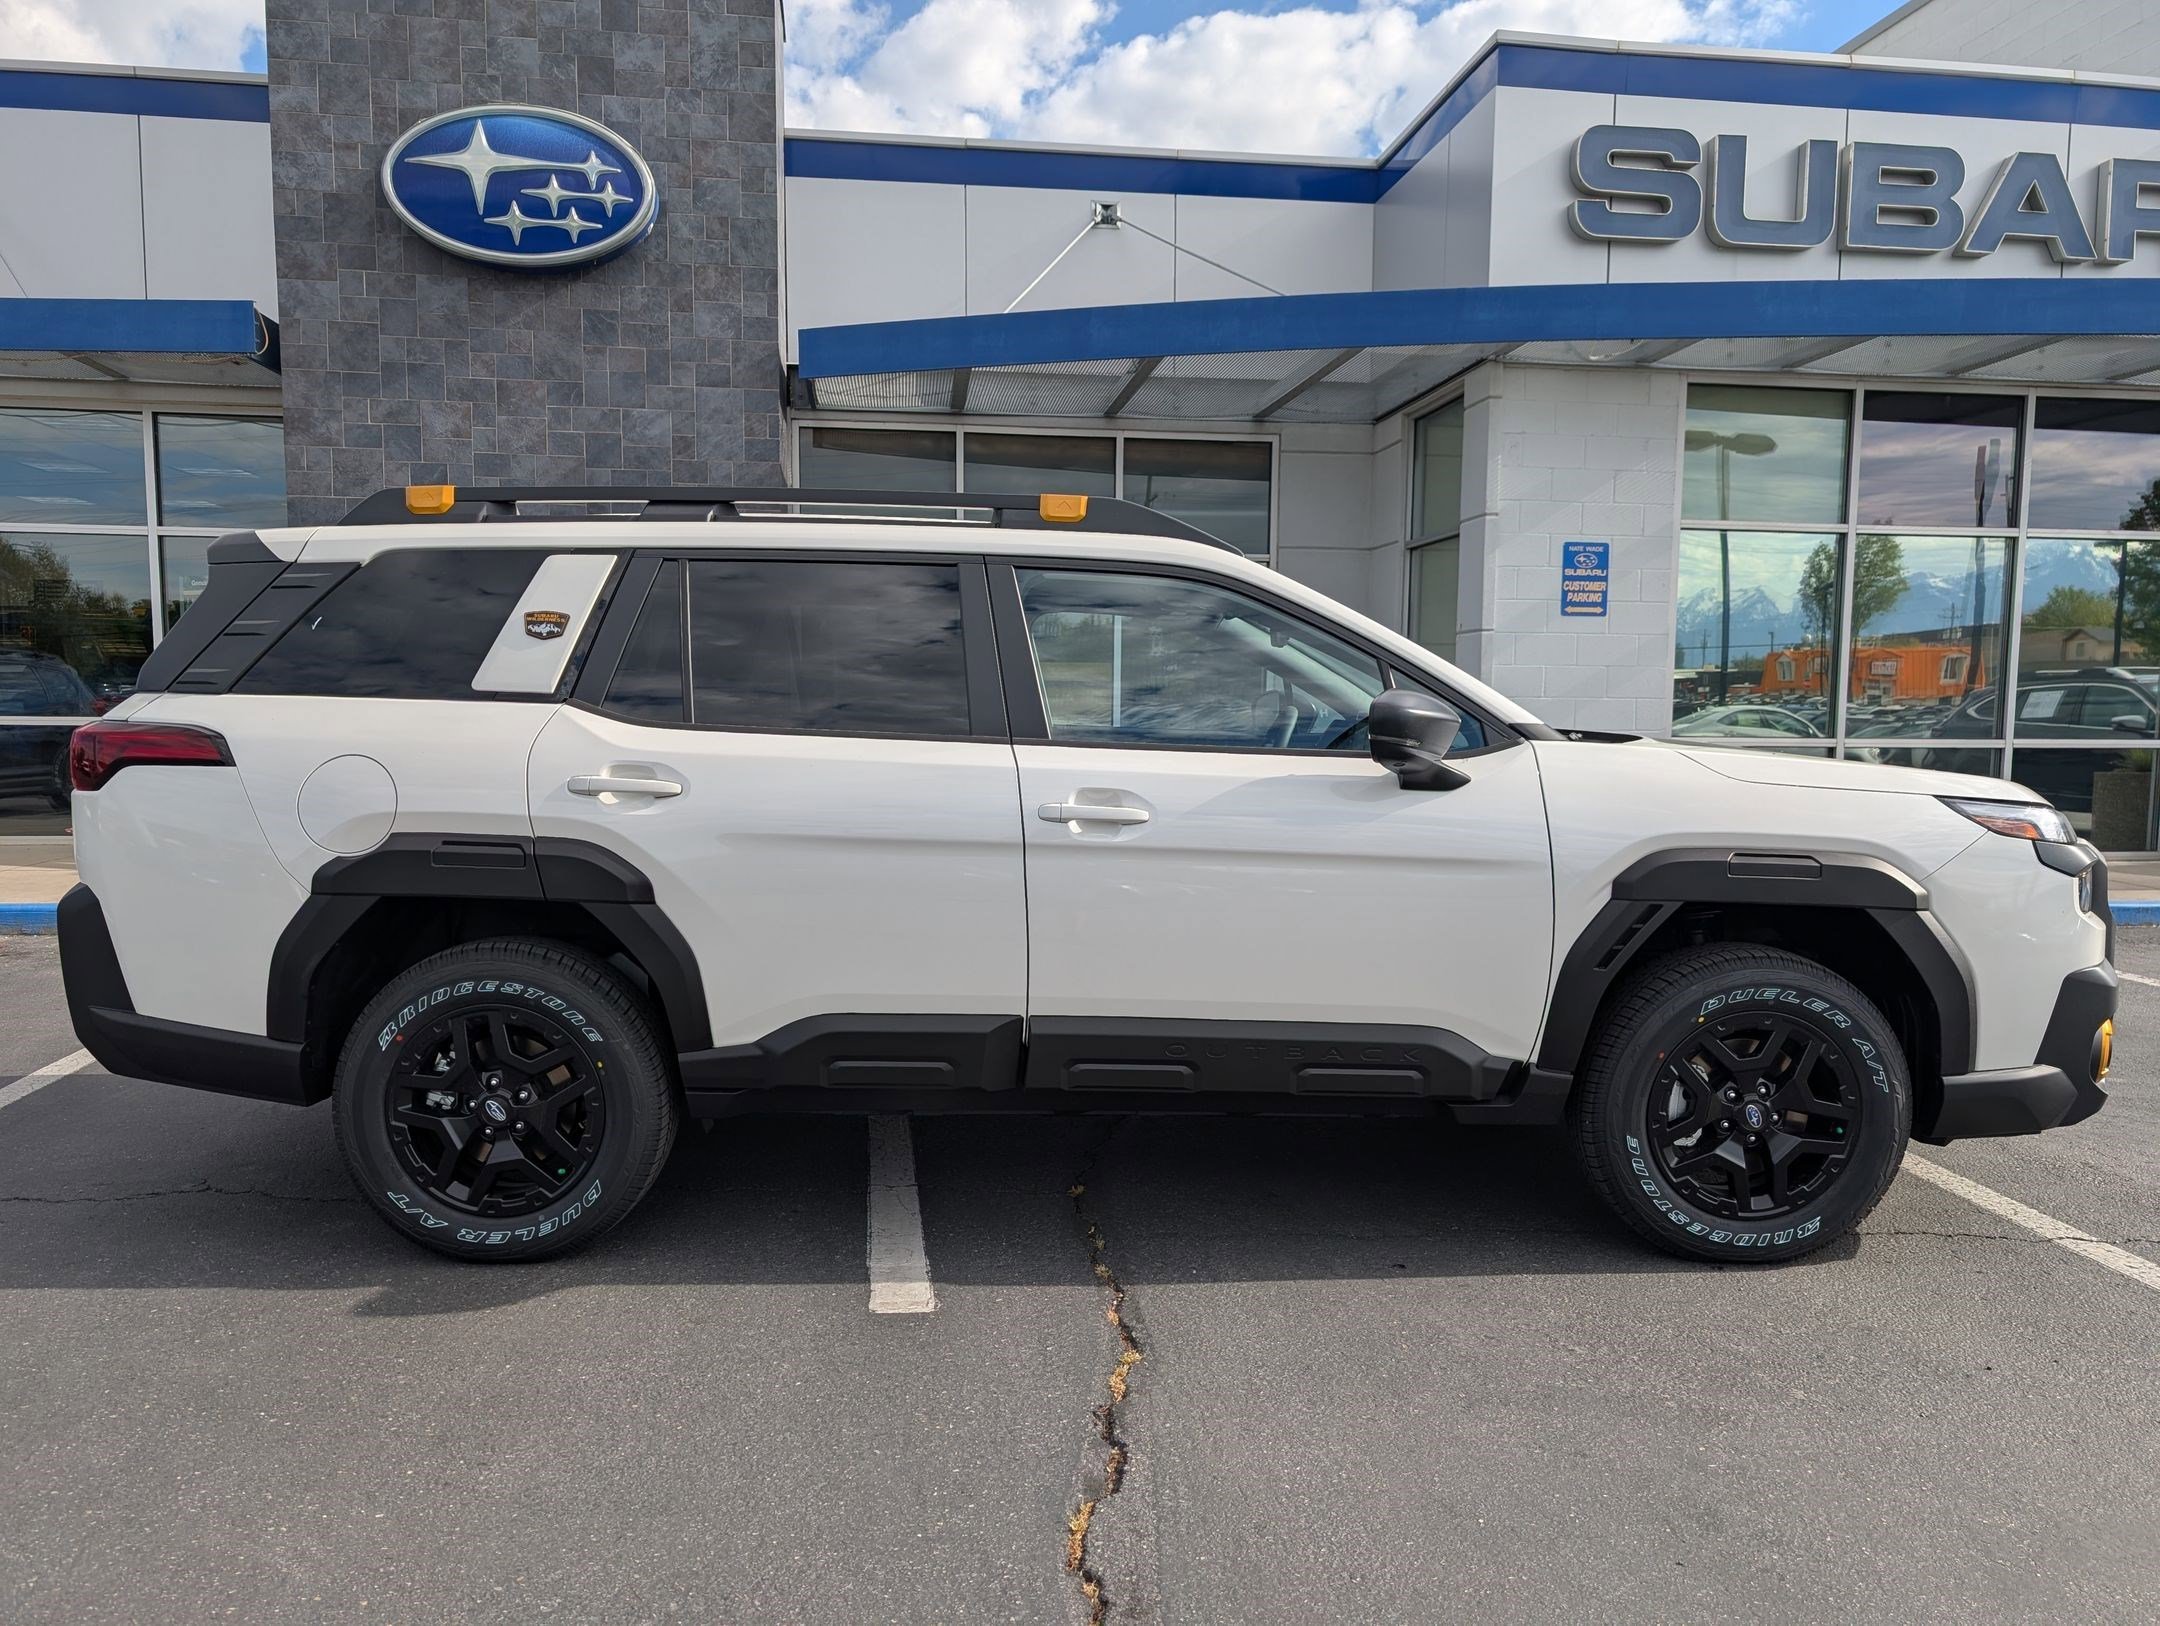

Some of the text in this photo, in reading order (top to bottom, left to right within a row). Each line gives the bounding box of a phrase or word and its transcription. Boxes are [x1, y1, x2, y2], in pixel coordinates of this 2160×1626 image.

[1563, 581, 1607, 592] CUSTOMER
[1564, 568, 1607, 577] SUBARU
[1566, 592, 1603, 603] PARKING
[378, 980, 603, 1051] BRIDGESTONE
[1700, 987, 1852, 1029] DUELER
[1163, 1044, 1422, 1063] OUTBACK
[1626, 1134, 1822, 1247] BRIDGESTONE
[456, 1179, 603, 1245] DUELER
